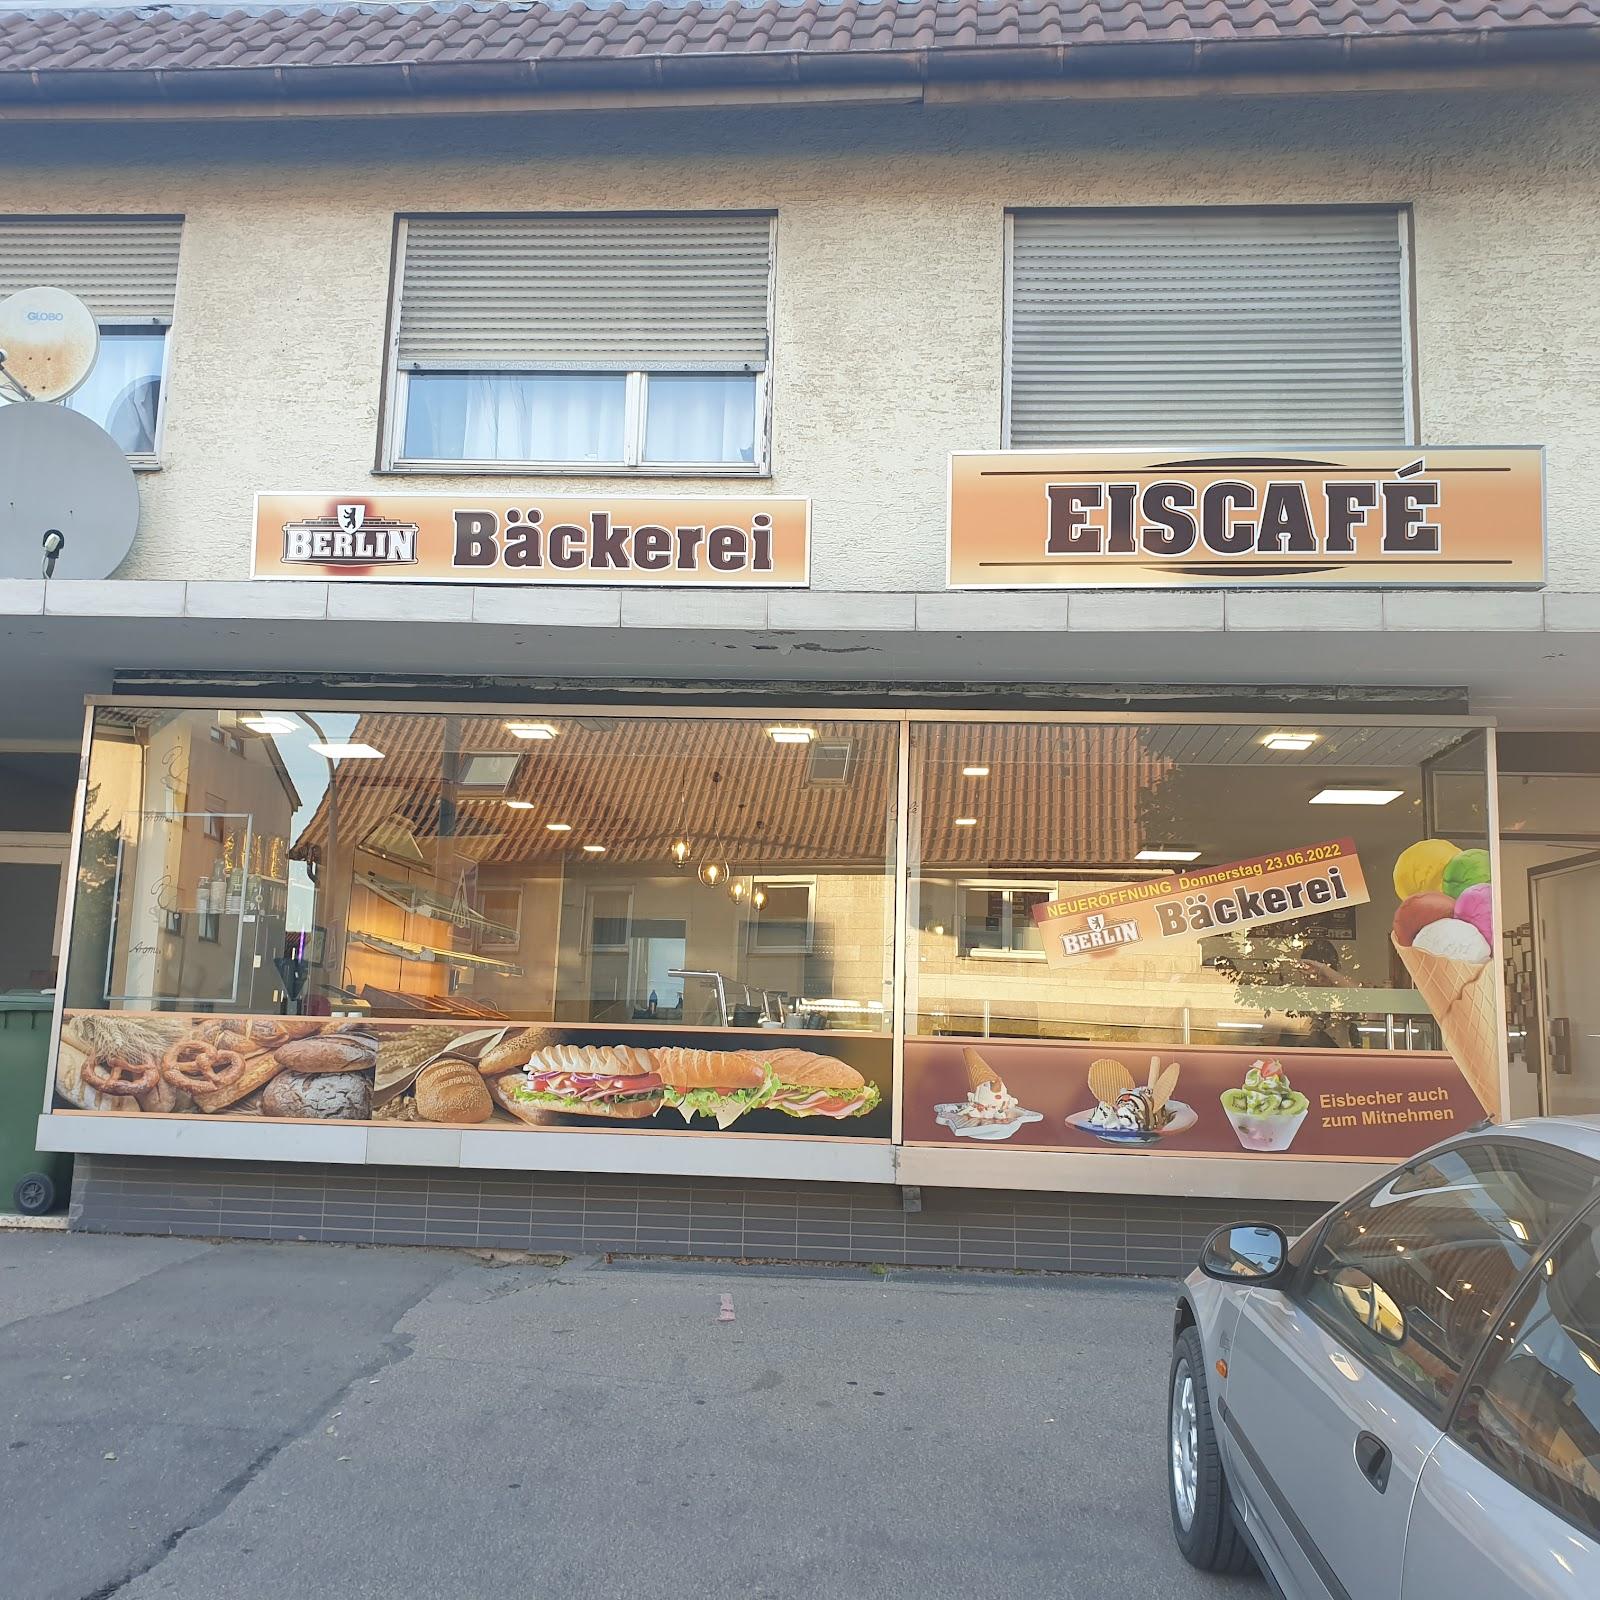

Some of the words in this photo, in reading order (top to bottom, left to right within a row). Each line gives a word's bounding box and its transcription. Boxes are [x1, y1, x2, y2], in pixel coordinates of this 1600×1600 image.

[27, 311, 64, 321] GLOBO
[1045, 457, 1441, 556] EISCAFÉ
[286, 528, 415, 561] BERLIN
[452, 507, 775, 573] Bäckerei
[1046, 880, 1172, 918] NEUERÖFFNUNG
[1178, 860, 1263, 890] Donnerstag
[1264, 843, 1342, 873] 23.06.2022
[1154, 865, 1349, 938] Bäckerei
[1062, 919, 1140, 956] BERLIN
[1319, 1090, 1403, 1109] Eisbecher
[1407, 1086, 1449, 1103] auch
[1321, 1114, 1357, 1128] zum
[1361, 1108, 1454, 1126] Mitnehmen
